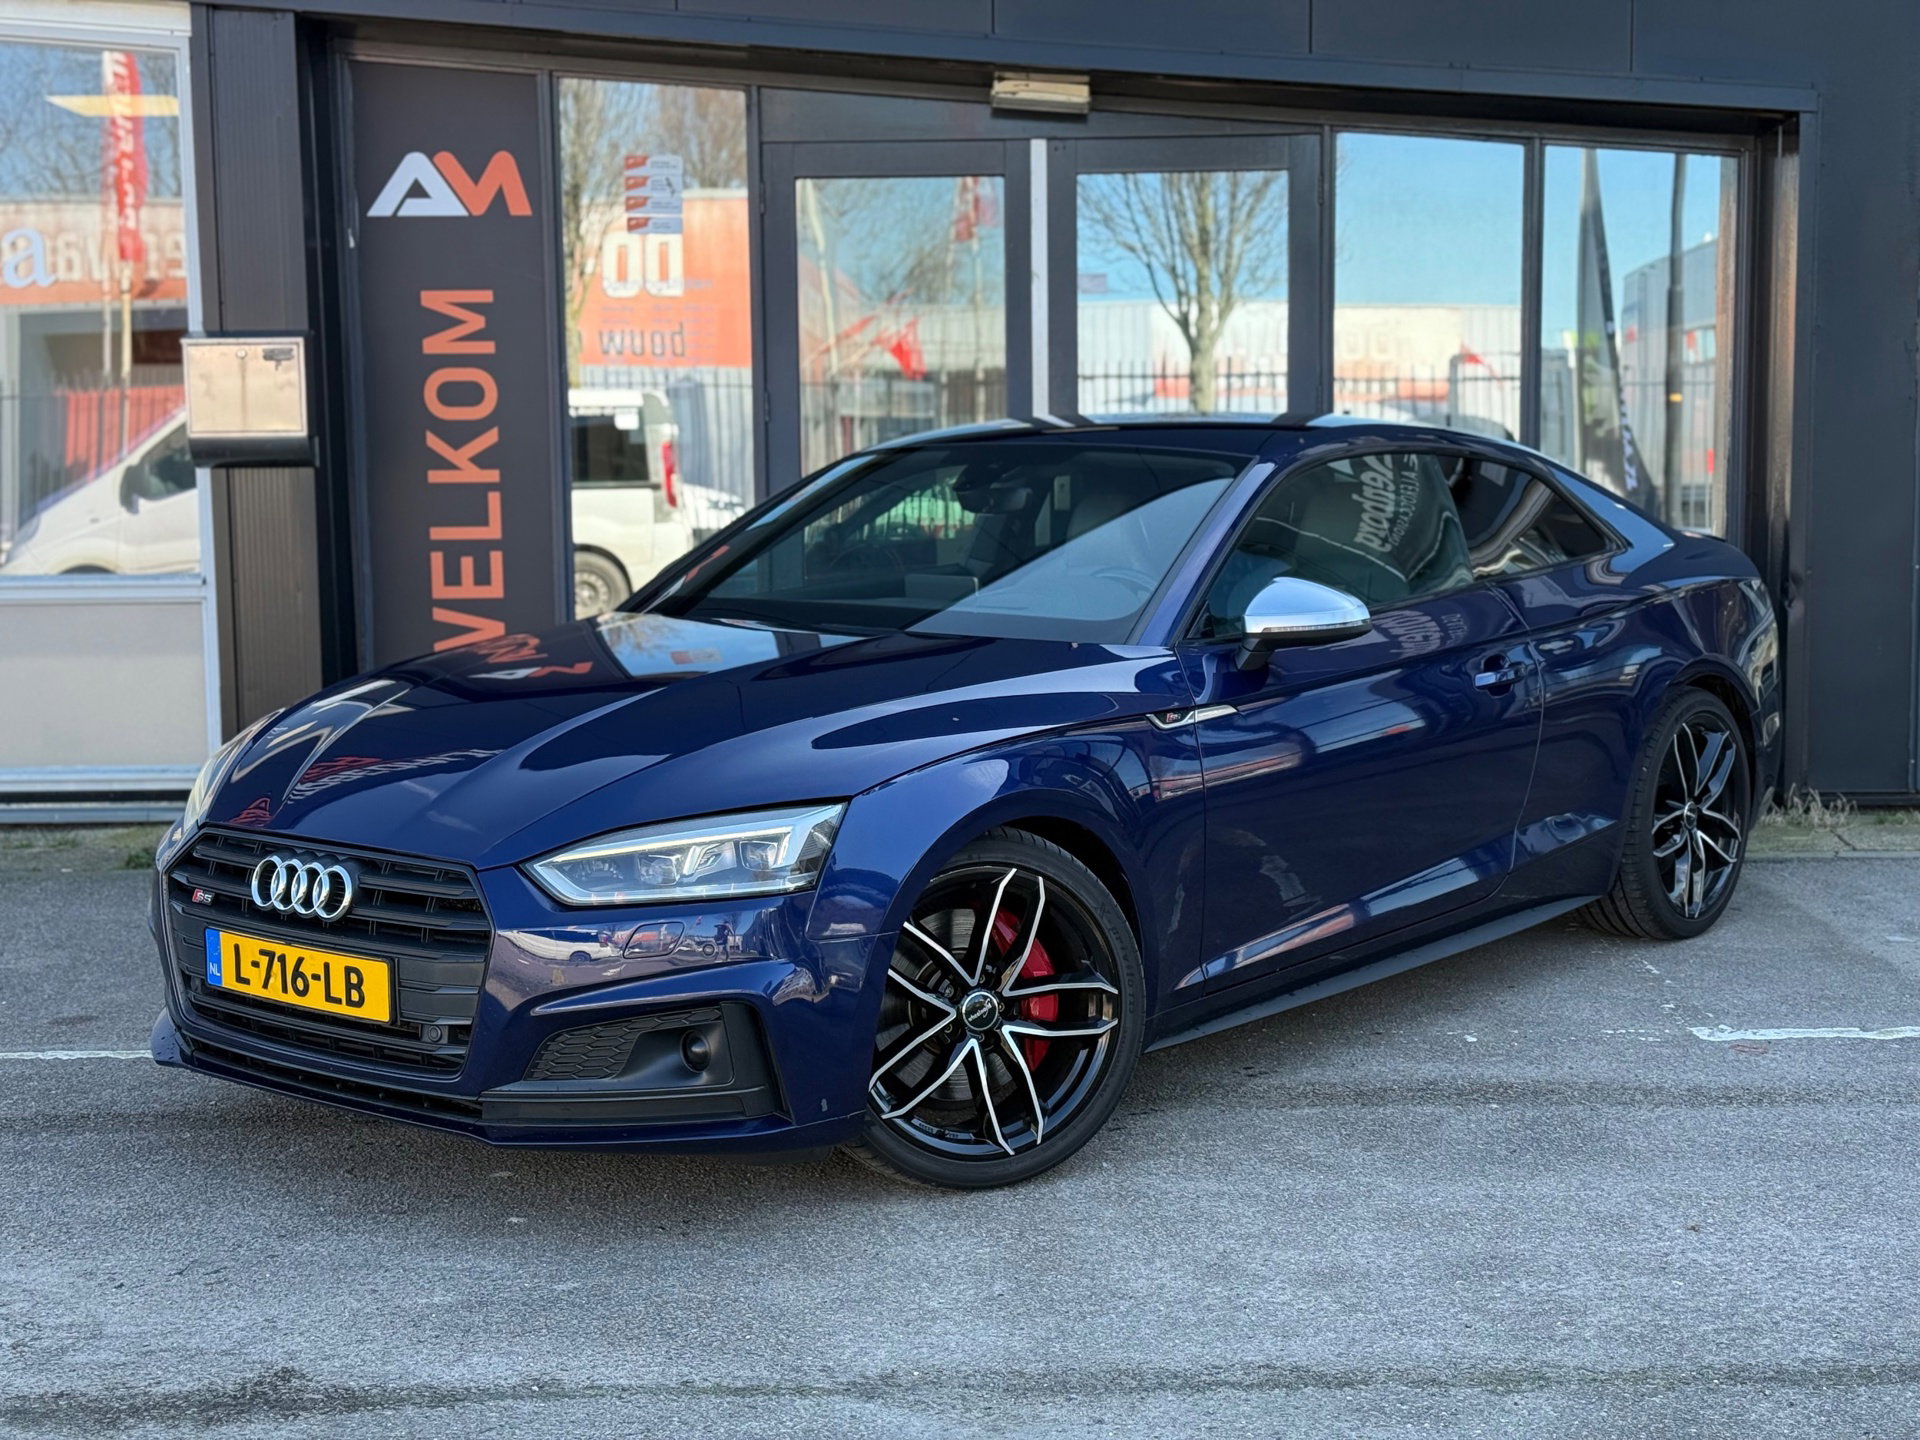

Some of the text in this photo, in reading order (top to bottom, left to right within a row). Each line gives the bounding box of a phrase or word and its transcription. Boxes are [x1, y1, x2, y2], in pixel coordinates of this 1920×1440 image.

[367, 151, 533, 217] AM
[193, 889, 212, 904] S5
[209, 943, 366, 1009] NL L-716-LB
